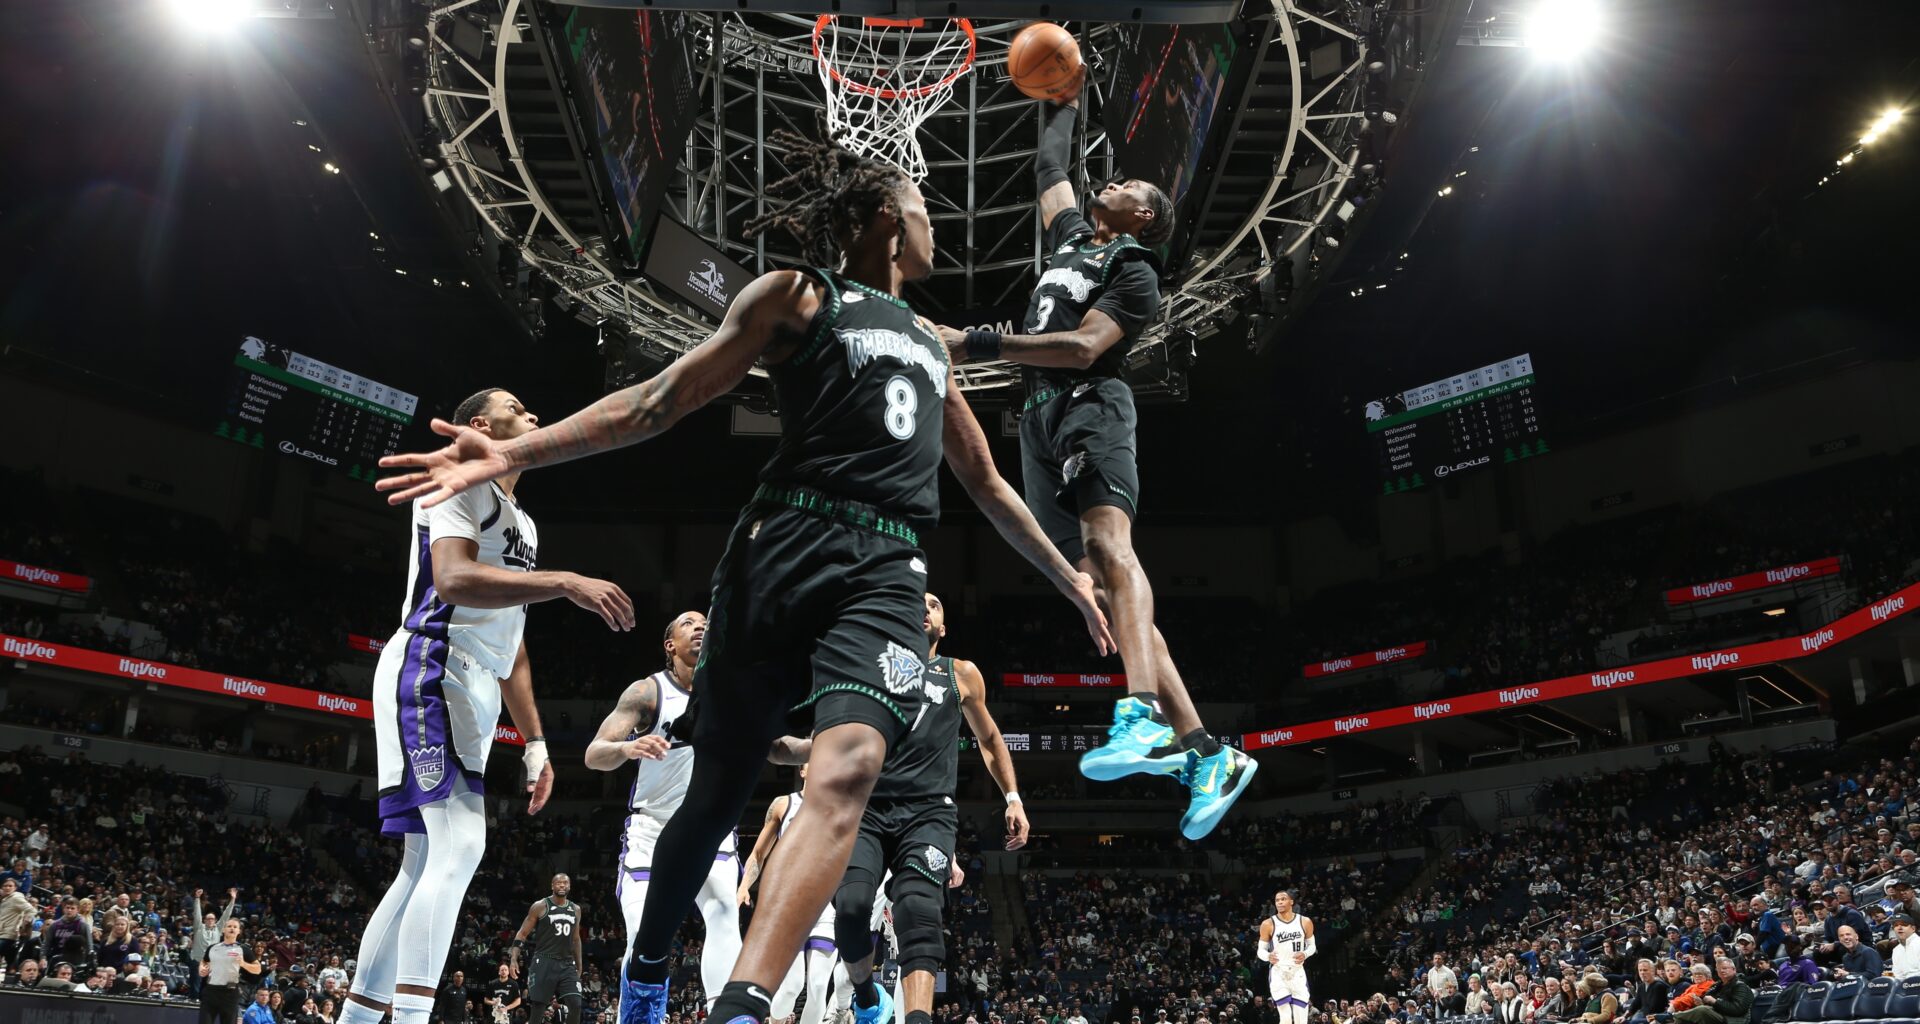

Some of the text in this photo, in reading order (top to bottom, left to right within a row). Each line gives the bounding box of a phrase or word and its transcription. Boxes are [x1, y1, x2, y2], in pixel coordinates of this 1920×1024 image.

[688, 270, 708, 292] Treasure
[712, 287, 728, 304] Island
[1028, 294, 1056, 335] 3
[290, 364, 304, 373] 41.2
[358, 380, 368, 388] AST
[250, 374, 288, 392] DiVincenzo
[392, 422, 403, 431] 1/5
[344, 396, 355, 404] AST
[884, 374, 918, 440] 8
[1407, 399, 1420, 407] 41.2
[1422, 394, 1435, 402] 33.3
[1465, 394, 1475, 402] AST
[239, 411, 263, 424] Randle
[242, 402, 266, 415] Gobert
[323, 428, 331, 436] 10
[248, 383, 282, 400] McDaniels
[390, 431, 400, 440] 1/4
[1384, 423, 1417, 436] DiVincenzo
[1519, 388, 1530, 396] 1/5
[245, 393, 269, 406] Hyland
[387, 440, 397, 449] 1/3
[1386, 432, 1416, 445] McDaniels
[1521, 397, 1532, 405] 1/4
[1388, 443, 1409, 454] Hyland
[1523, 407, 1534, 415] 1/3
[1390, 452, 1411, 462] Gobert
[1524, 416, 1536, 424] 0/0
[295, 446, 338, 466] LEXUS
[1392, 461, 1413, 471] Randle
[1528, 425, 1538, 433] 1/3
[1449, 456, 1490, 472] LEXUS
[502, 526, 536, 566] King
[15, 564, 60, 585] HyVee
[1766, 564, 1808, 583] HyVee
[1692, 580, 1733, 598] HyVee
[1870, 596, 1905, 620] HyVee
[3, 639, 56, 659] HyVee
[1801, 629, 1834, 651] HyVee
[119, 658, 166, 679] HyVee
[1322, 659, 1352, 673] HyVee
[1691, 652, 1739, 671] HyVee
[223, 677, 266, 696] HyVee
[1023, 674, 1055, 687] HyVee
[1080, 674, 1111, 687] HyVee
[1591, 670, 1635, 688] HyVee
[317, 694, 357, 712] HyVee
[1499, 687, 1539, 705] HyVee
[1414, 702, 1451, 719] HyVee
[495, 727, 518, 740] Vee
[1334, 717, 1369, 733] HyVee
[63, 736, 82, 747] 136
[1008, 742, 1029, 751] NGS
[1260, 730, 1293, 745] HyVee
[1664, 744, 1680, 753] 106
[414, 763, 443, 775] KINGS
[554, 923, 570, 936] 30
[1276, 930, 1302, 942] Kings
[1292, 942, 1301, 952] 18
